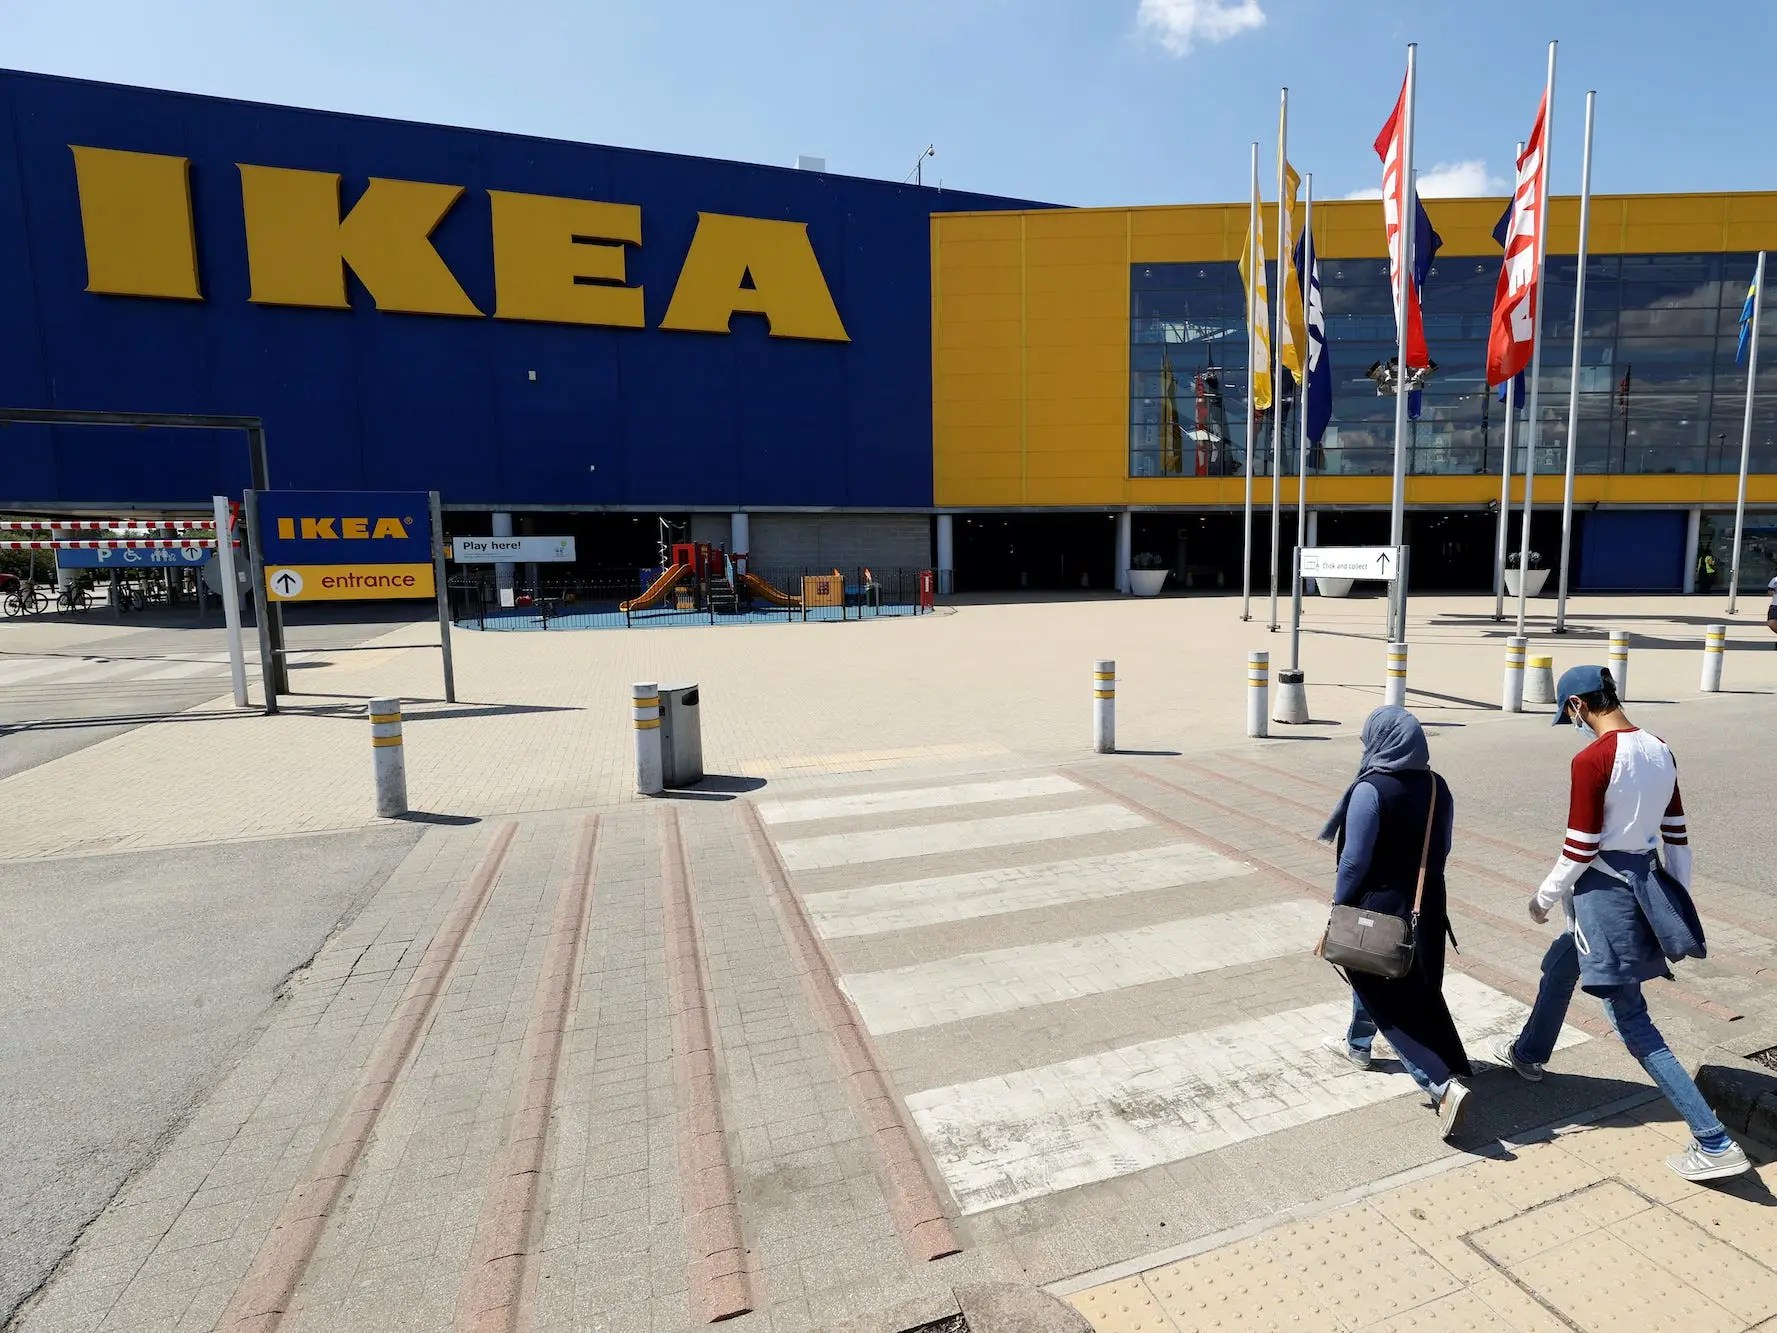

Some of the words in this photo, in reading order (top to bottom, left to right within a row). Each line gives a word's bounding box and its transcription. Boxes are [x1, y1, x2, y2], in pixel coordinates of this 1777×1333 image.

[67, 144, 851, 342] IKEA
[463, 541, 487, 552] Play
[491, 541, 521, 550] here!
[97, 549, 112, 562] P
[1348, 562, 1368, 570] collect
[321, 572, 416, 588] entrance
